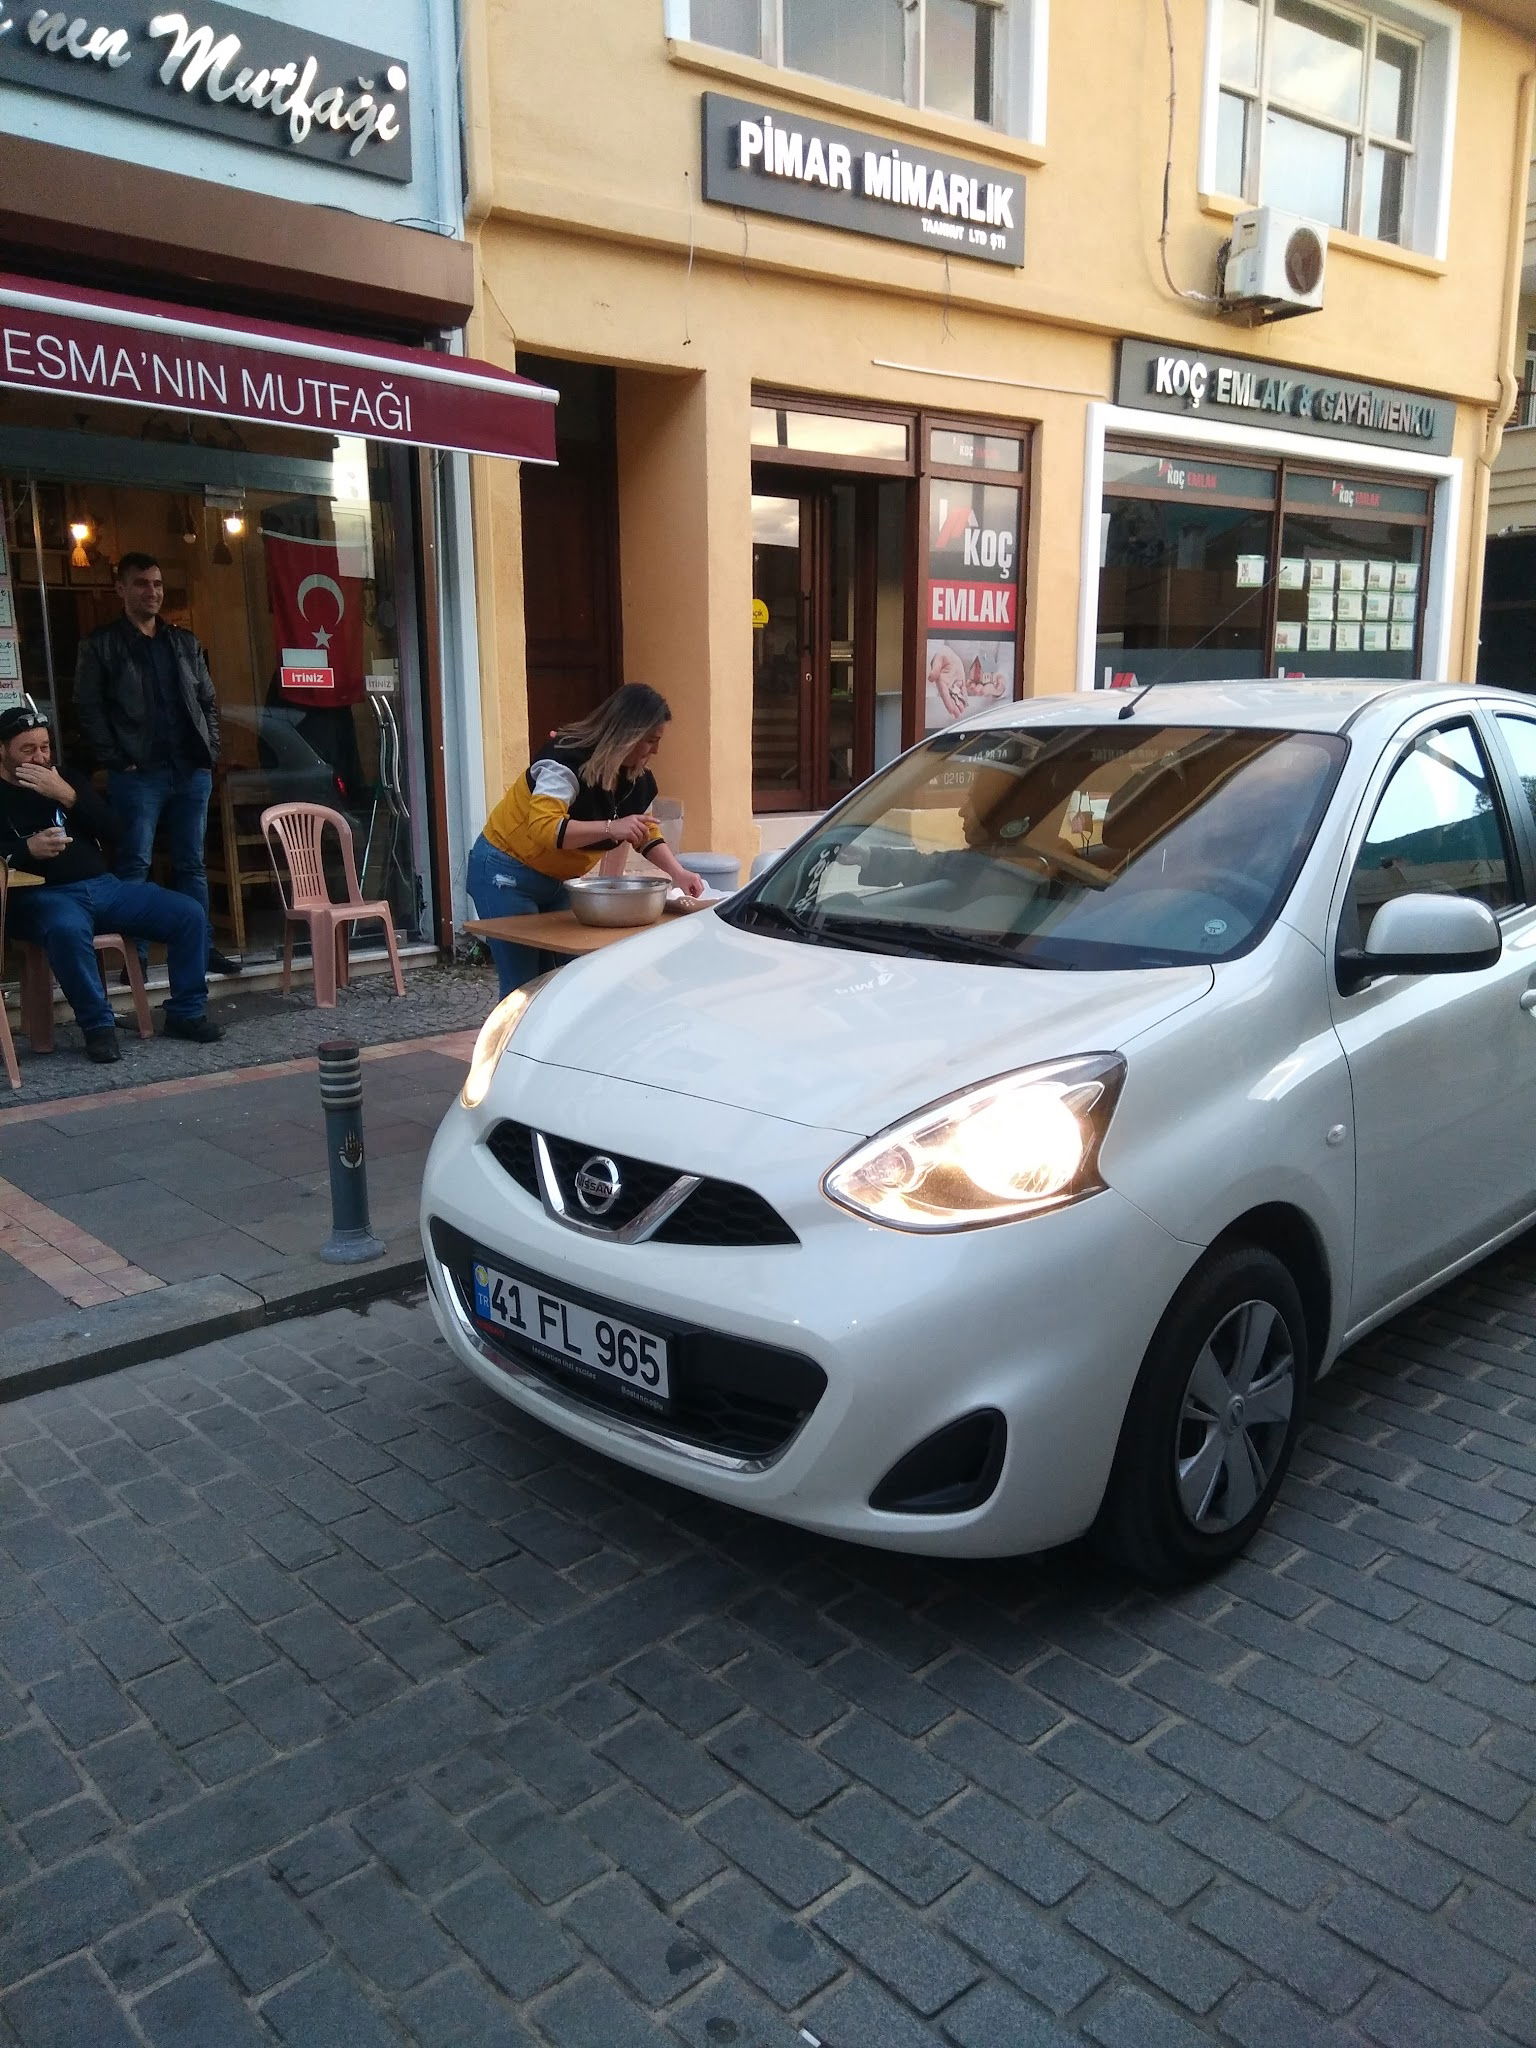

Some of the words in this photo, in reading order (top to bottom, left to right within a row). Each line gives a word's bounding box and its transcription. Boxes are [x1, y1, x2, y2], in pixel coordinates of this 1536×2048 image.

[740, 115, 852, 190] PİMAR
[864, 150, 1014, 229] MİMARLIK
[242, 368, 412, 432] MUTFAĞI
[1156, 356, 1208, 408] KOÇ
[1216, 367, 1293, 413] EMLAK
[1299, 384, 1313, 417] &
[1167, 469, 1185, 489] KOÇ
[1339, 489, 1354, 507] KOÇ
[964, 528, 1013, 579] KOÇ
[932, 587, 1011, 624] EMLAK
[577, 1174, 613, 1195] NISSAN
[478, 1293, 489, 1306] TR
[491, 1278, 527, 1330] 41
[537, 1295, 582, 1356] FL
[595, 1321, 660, 1387] 965
